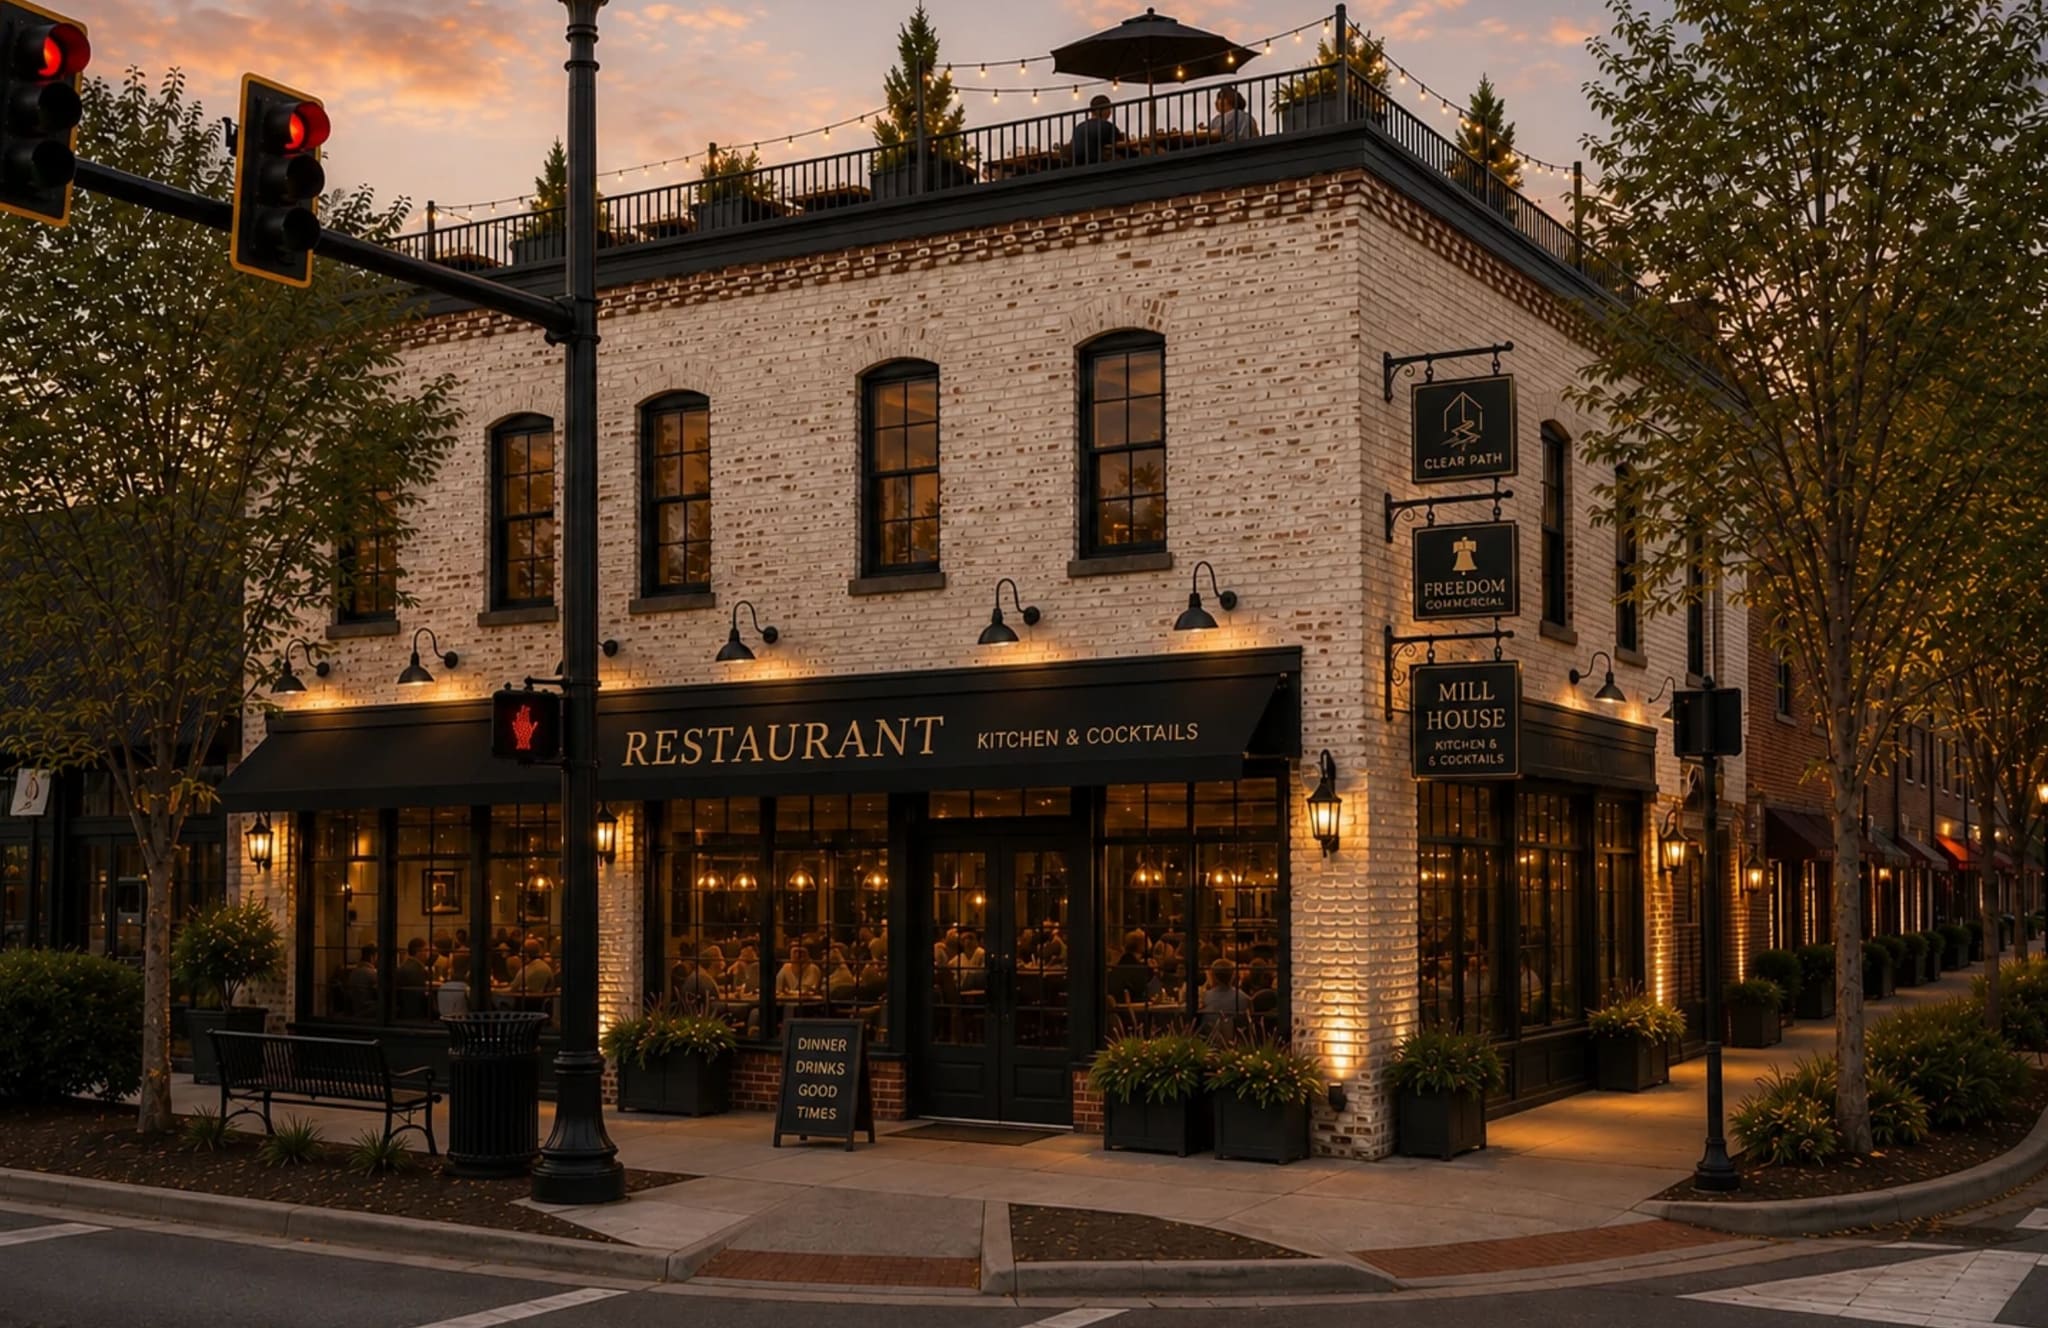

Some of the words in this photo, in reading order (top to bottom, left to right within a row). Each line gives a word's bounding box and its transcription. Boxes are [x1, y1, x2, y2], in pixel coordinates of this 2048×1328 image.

[1424, 456, 1465, 470] CLEAR
[1470, 452, 1502, 465] PATH
[1424, 578, 1505, 597] FREEDOM
[1439, 681, 1495, 702] MILL
[1426, 708, 1506, 730] HOUSE
[621, 715, 944, 767] RESTAURANT
[977, 729, 1059, 749] KITCHEN
[1066, 729, 1079, 746] &
[1086, 723, 1199, 744] COCKTAILS
[1435, 739, 1485, 751] KITCHEN
[1440, 753, 1504, 766] COCKTAILS
[797, 1037, 848, 1052] DINNER
[795, 1060, 846, 1076] DRINKS
[798, 1083, 838, 1098] GOOD
[797, 1105, 837, 1120] TIMES
